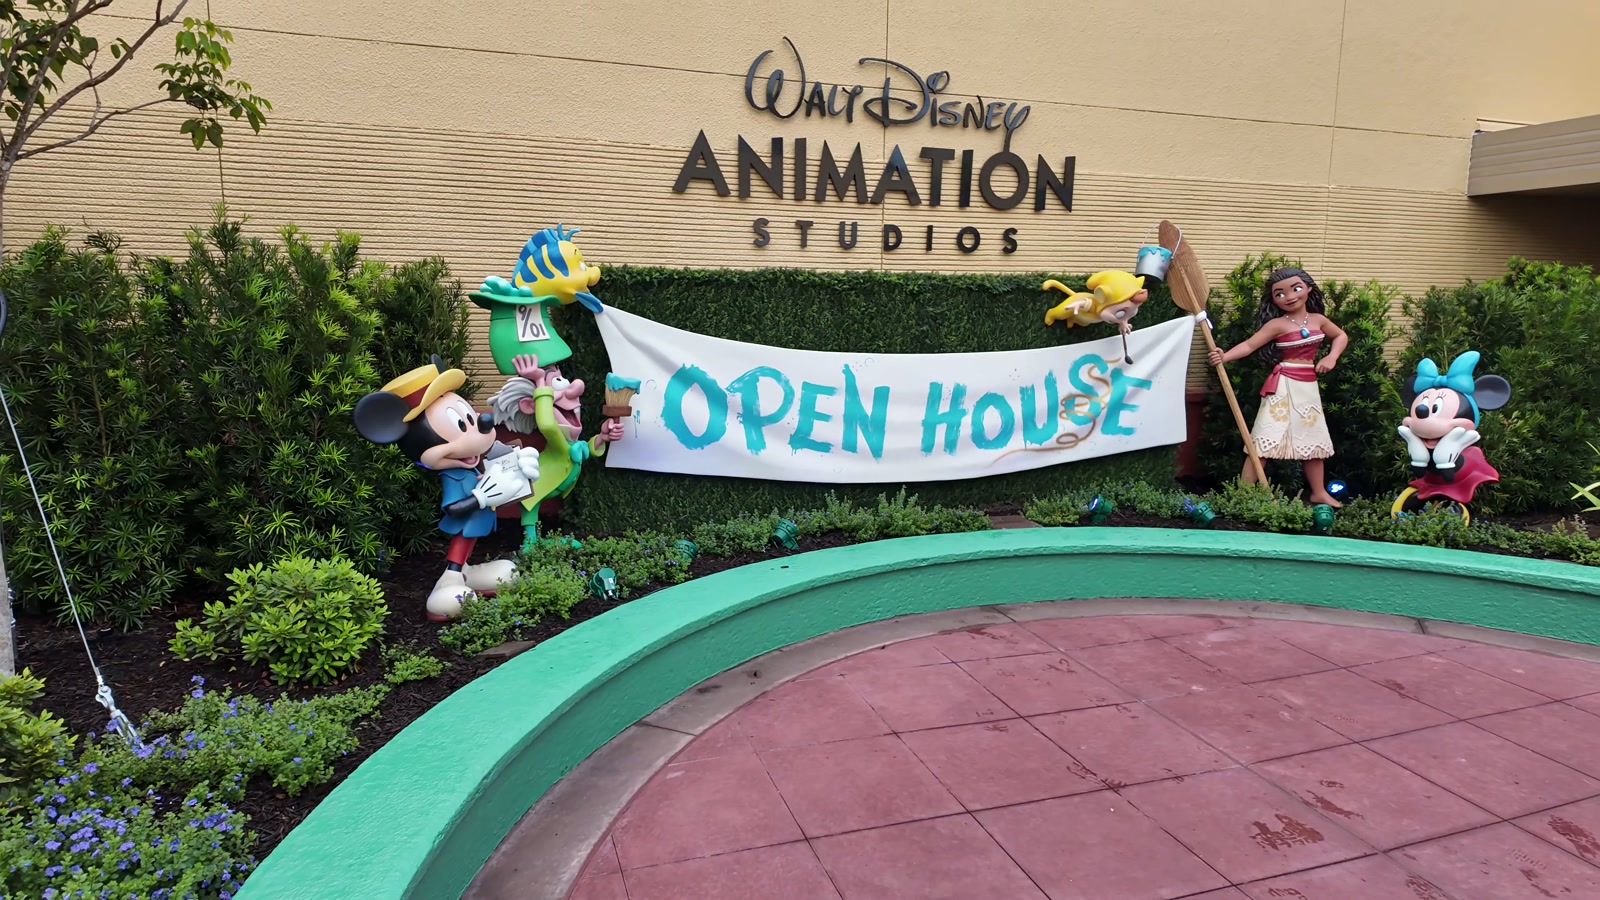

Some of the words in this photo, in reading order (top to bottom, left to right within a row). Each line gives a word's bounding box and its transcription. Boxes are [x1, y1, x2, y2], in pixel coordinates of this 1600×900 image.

[672, 128, 1076, 212] ANIMATION
[753, 217, 1018, 254] STUDIOS
[660, 363, 890, 463] OPEN
[921, 353, 1153, 456] HOUSE
